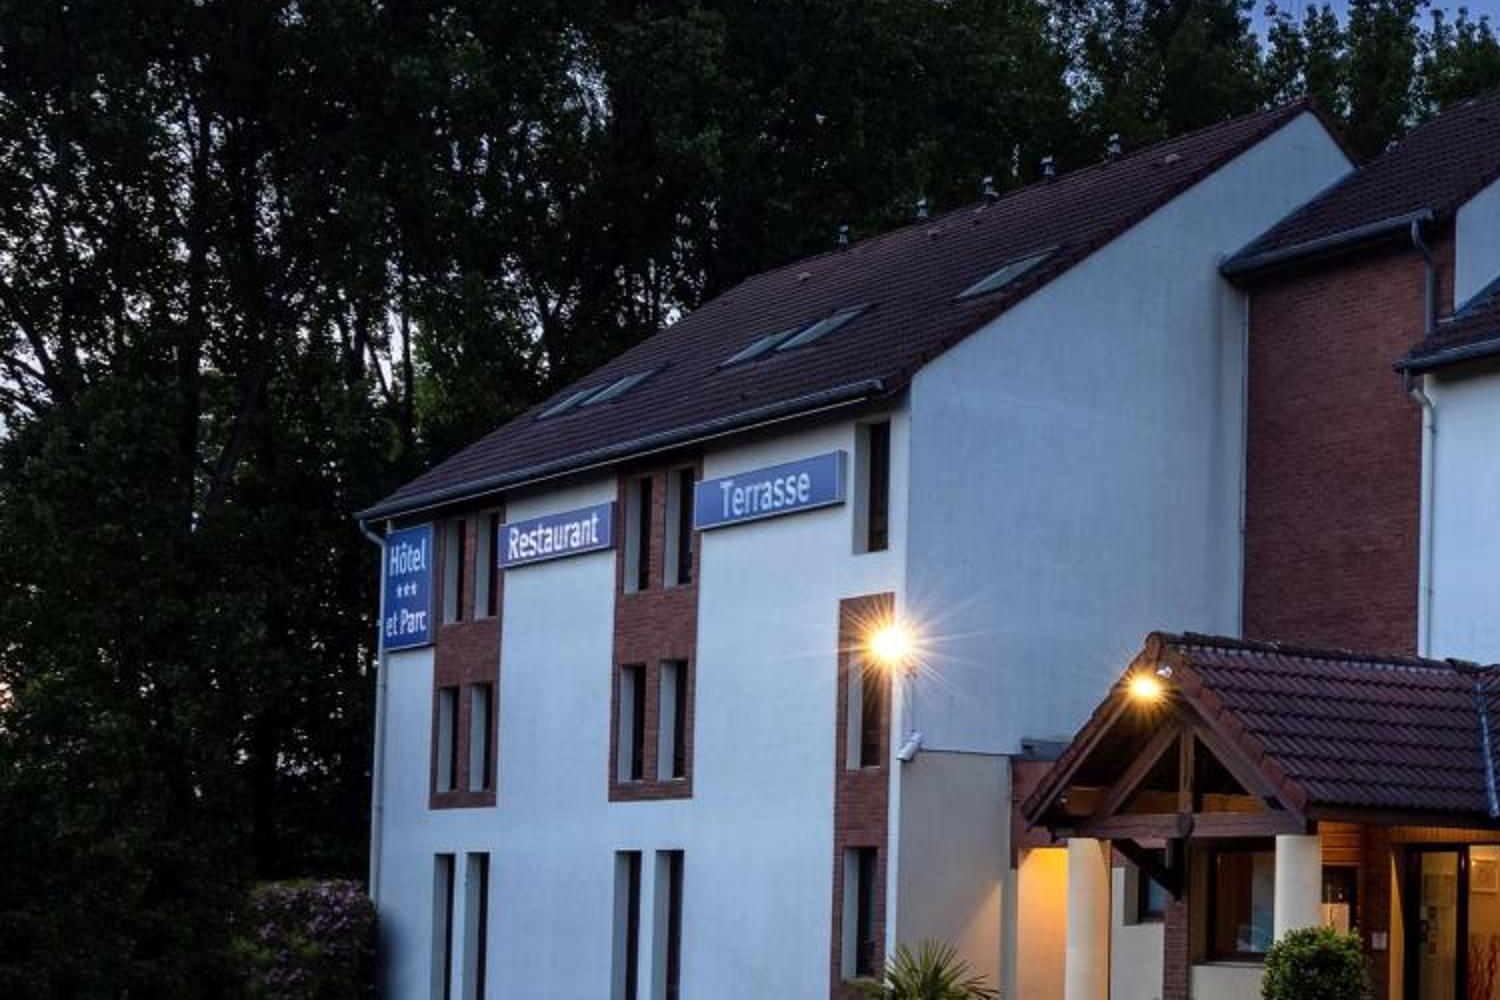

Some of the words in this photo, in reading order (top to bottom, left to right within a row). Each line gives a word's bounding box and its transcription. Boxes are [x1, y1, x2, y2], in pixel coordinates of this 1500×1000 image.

[720, 472, 810, 518] Terrasse
[508, 511, 599, 560] Restaurant
[389, 538, 427, 576] Hôtel
[385, 611, 398, 638] et
[400, 607, 427, 635] Parc
